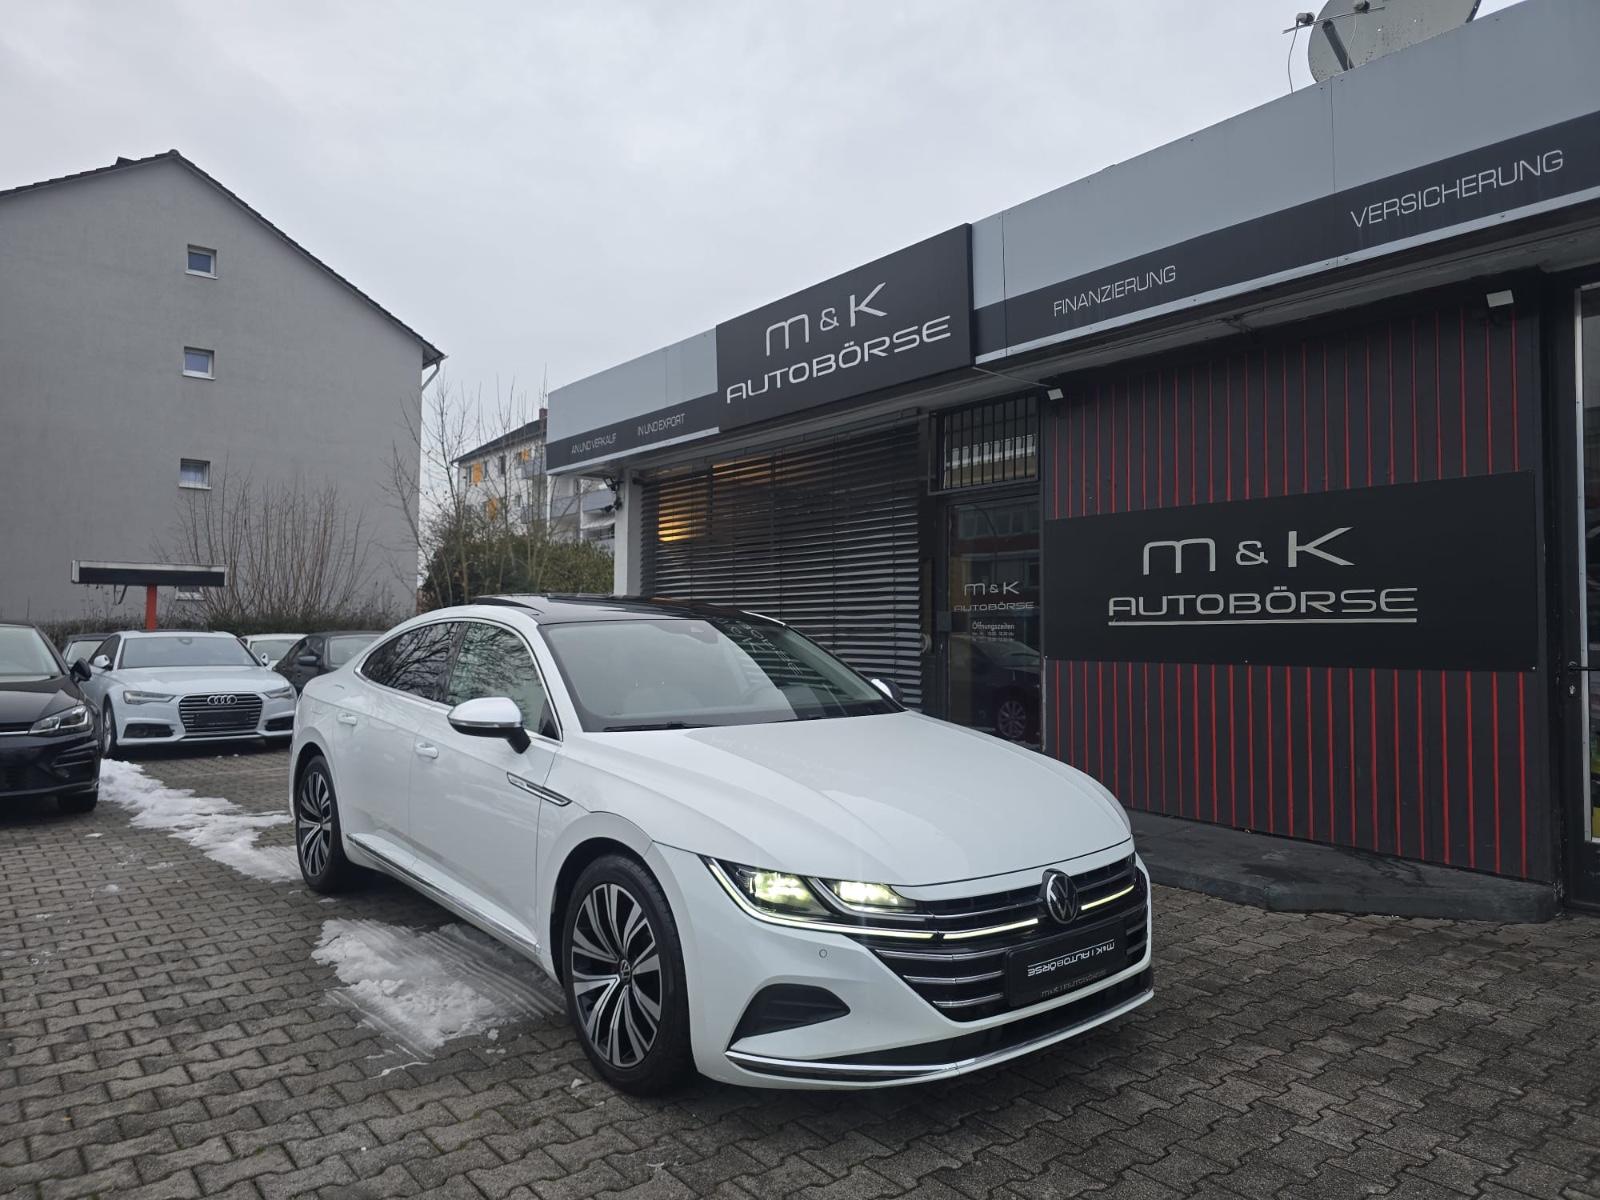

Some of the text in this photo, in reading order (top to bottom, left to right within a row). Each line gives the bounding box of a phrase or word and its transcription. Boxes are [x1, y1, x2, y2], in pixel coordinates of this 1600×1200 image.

[1350, 149, 1564, 229] VERSICHERUNG
[1053, 265, 1177, 317] FINANZIERUNG
[766, 282, 887, 357] M & K
[726, 315, 951, 404] AUTOBÖRSE
[658, 414, 686, 430] EXPORT
[1142, 526, 1356, 575] M & K
[953, 601, 1035, 612] AUTOBÖRSE
[964, 581, 1020, 596] M & K
[1108, 585, 1418, 617] AUTOBÖRSE
[1027, 952, 1089, 977] AUTOBÖRSE
